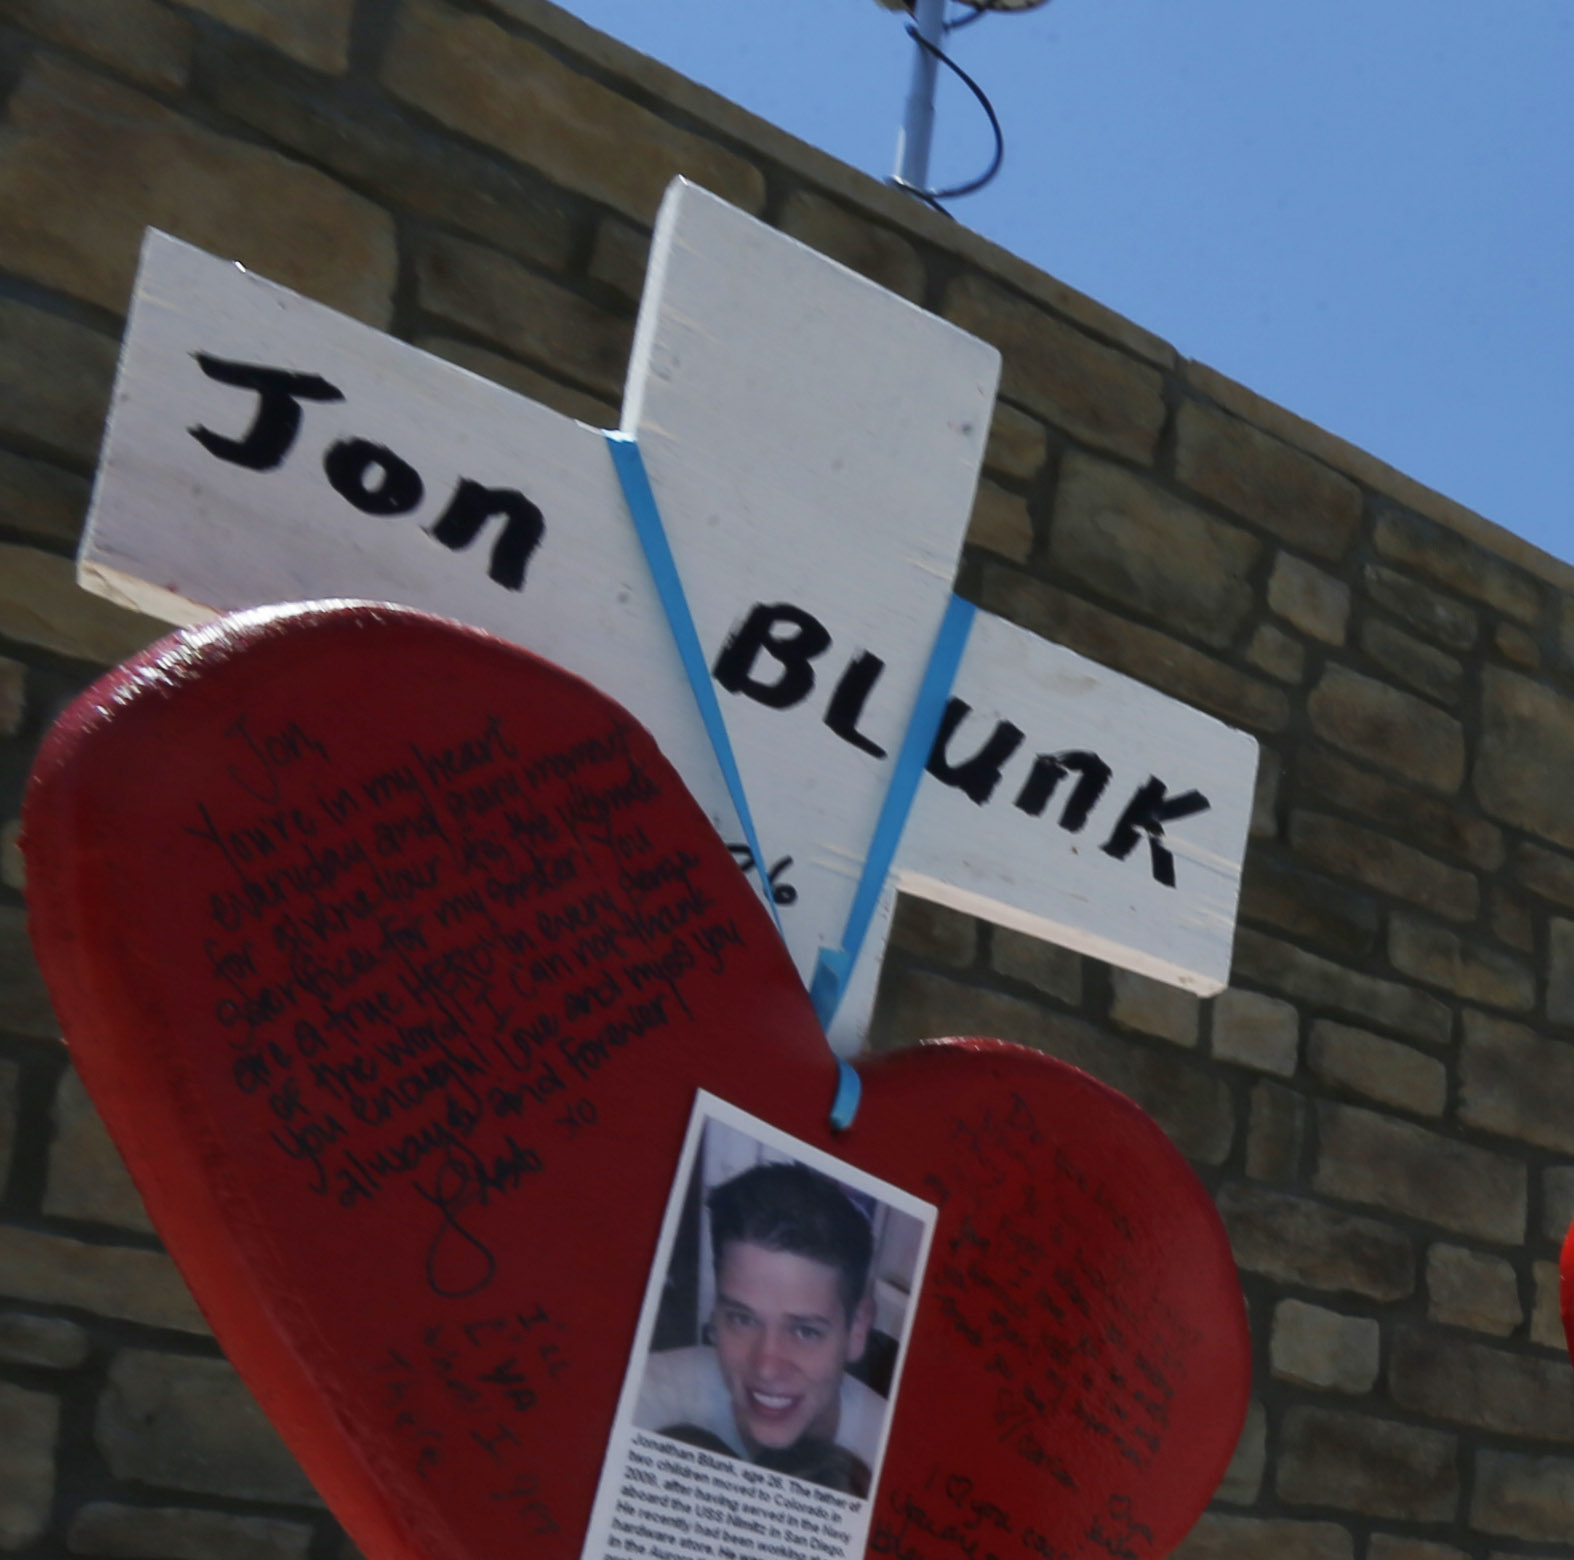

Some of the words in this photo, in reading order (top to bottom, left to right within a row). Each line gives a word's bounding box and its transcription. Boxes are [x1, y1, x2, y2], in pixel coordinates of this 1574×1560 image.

[186, 349, 546, 593] Jon
[318, 788, 360, 825] in
[362, 767, 430, 827] my
[411, 716, 517, 788] heart
[375, 804, 437, 856] and
[310, 1056, 379, 1099] the
[510, 952, 573, 998] can
[325, 992, 403, 1045] true
[272, 1114, 359, 1191] you
[692, 921, 744, 974] you
[488, 1061, 565, 1117] and
[629, 1450, 653, 1466] two
[657, 1461, 709, 1482] children
[712, 1477, 756, 1497] moved
[774, 1494, 828, 1519] Colorado
[633, 1436, 694, 1460] Jonathan
[742, 1470, 764, 1483] age
[790, 1481, 811, 1497] The
[814, 1490, 846, 1507] father
[613, 1519, 676, 1544] hardware
[719, 1548, 736, 1560] He
[617, 1501, 635, 1515] He
[639, 1509, 690, 1531] recently
[694, 1523, 720, 1539] had
[722, 1531, 754, 1547] been
[621, 1486, 669, 1507] aboard
[671, 1499, 692, 1513] the
[695, 1506, 723, 1522] USS
[784, 1530, 808, 1546] San
[809, 1537, 844, 1557] Diego,
[663, 1480, 692, 1495] after
[695, 1488, 739, 1512] having
[742, 1504, 785, 1523] served
[801, 1519, 820, 1533] the
[822, 1524, 850, 1544] Navy
[624, 1539, 646, 1554] the
